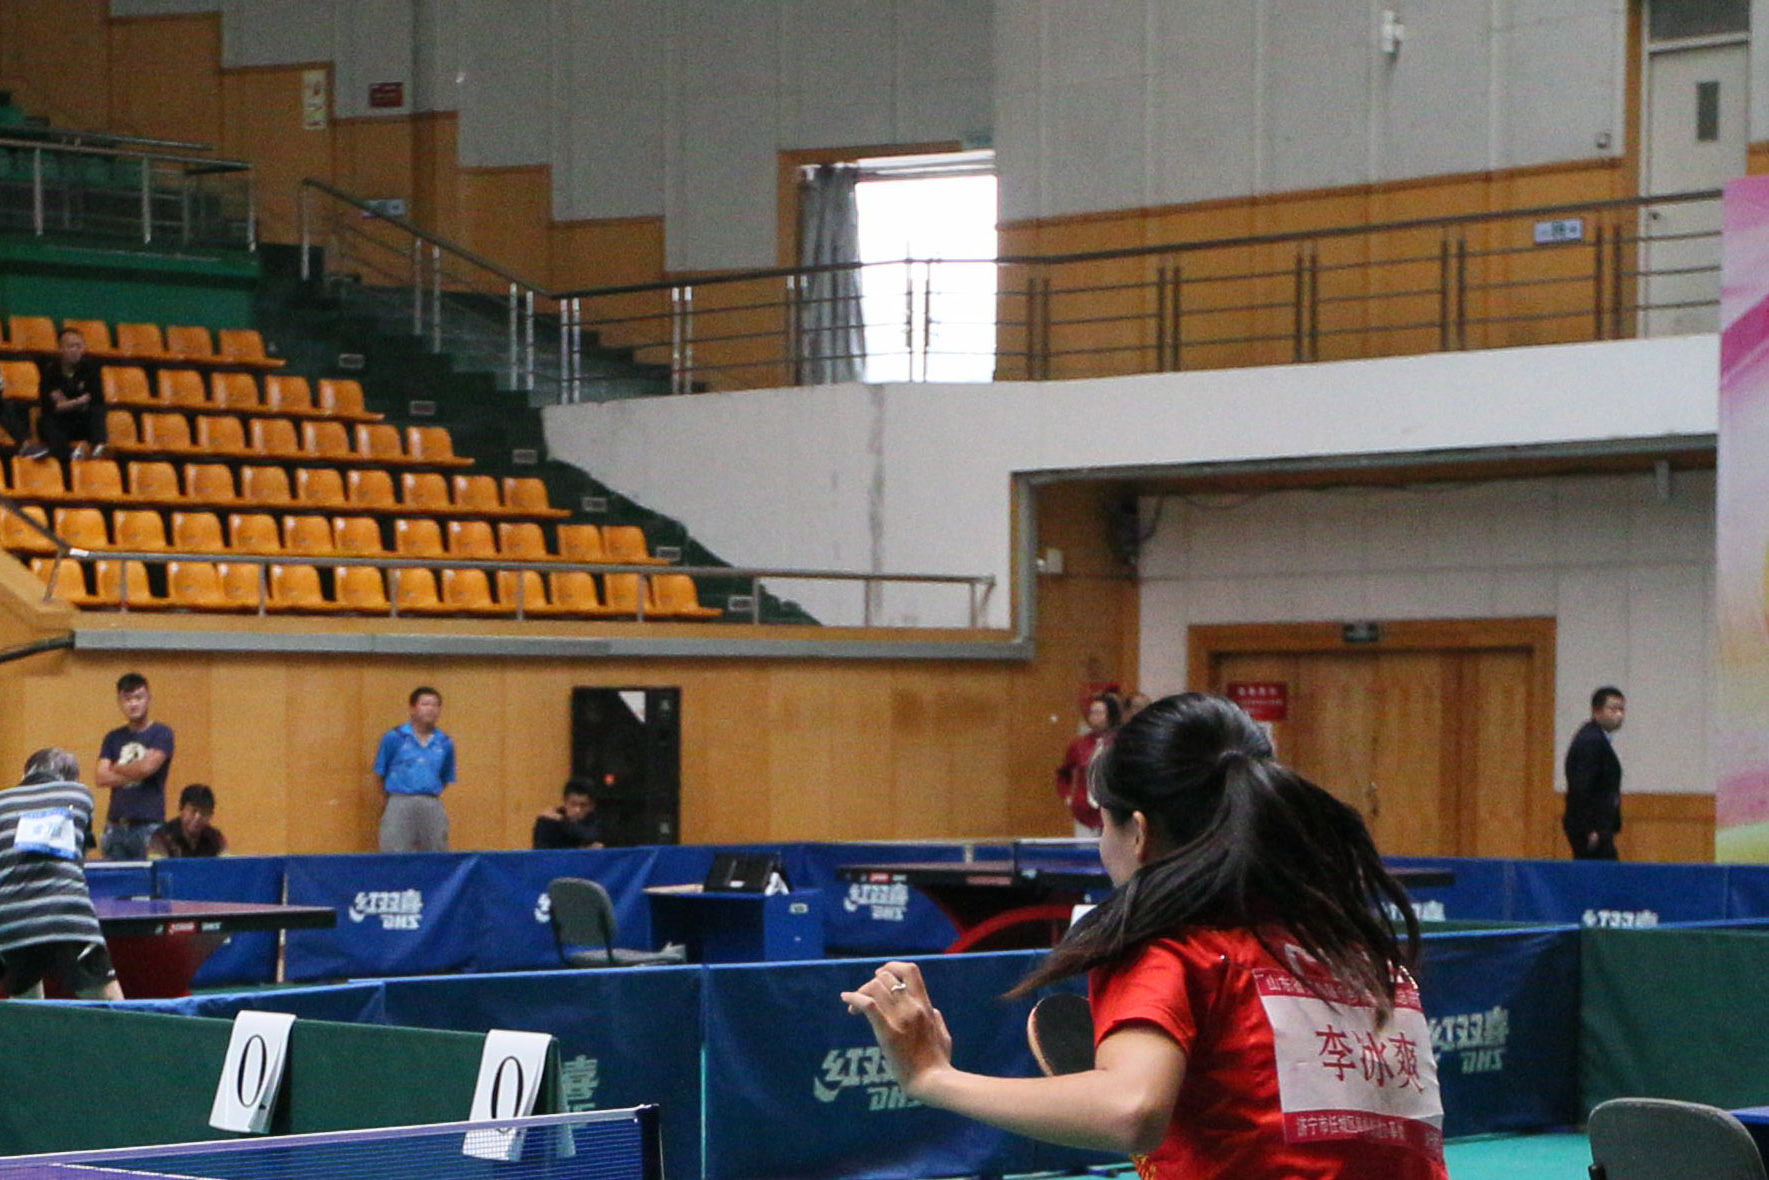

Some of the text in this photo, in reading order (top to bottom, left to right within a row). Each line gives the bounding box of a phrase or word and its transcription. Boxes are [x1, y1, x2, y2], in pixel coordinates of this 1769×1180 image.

[236, 1033, 269, 1109] 0
[489, 1054, 526, 1134] 0
[1315, 1023, 1425, 1093] 李冰爽
